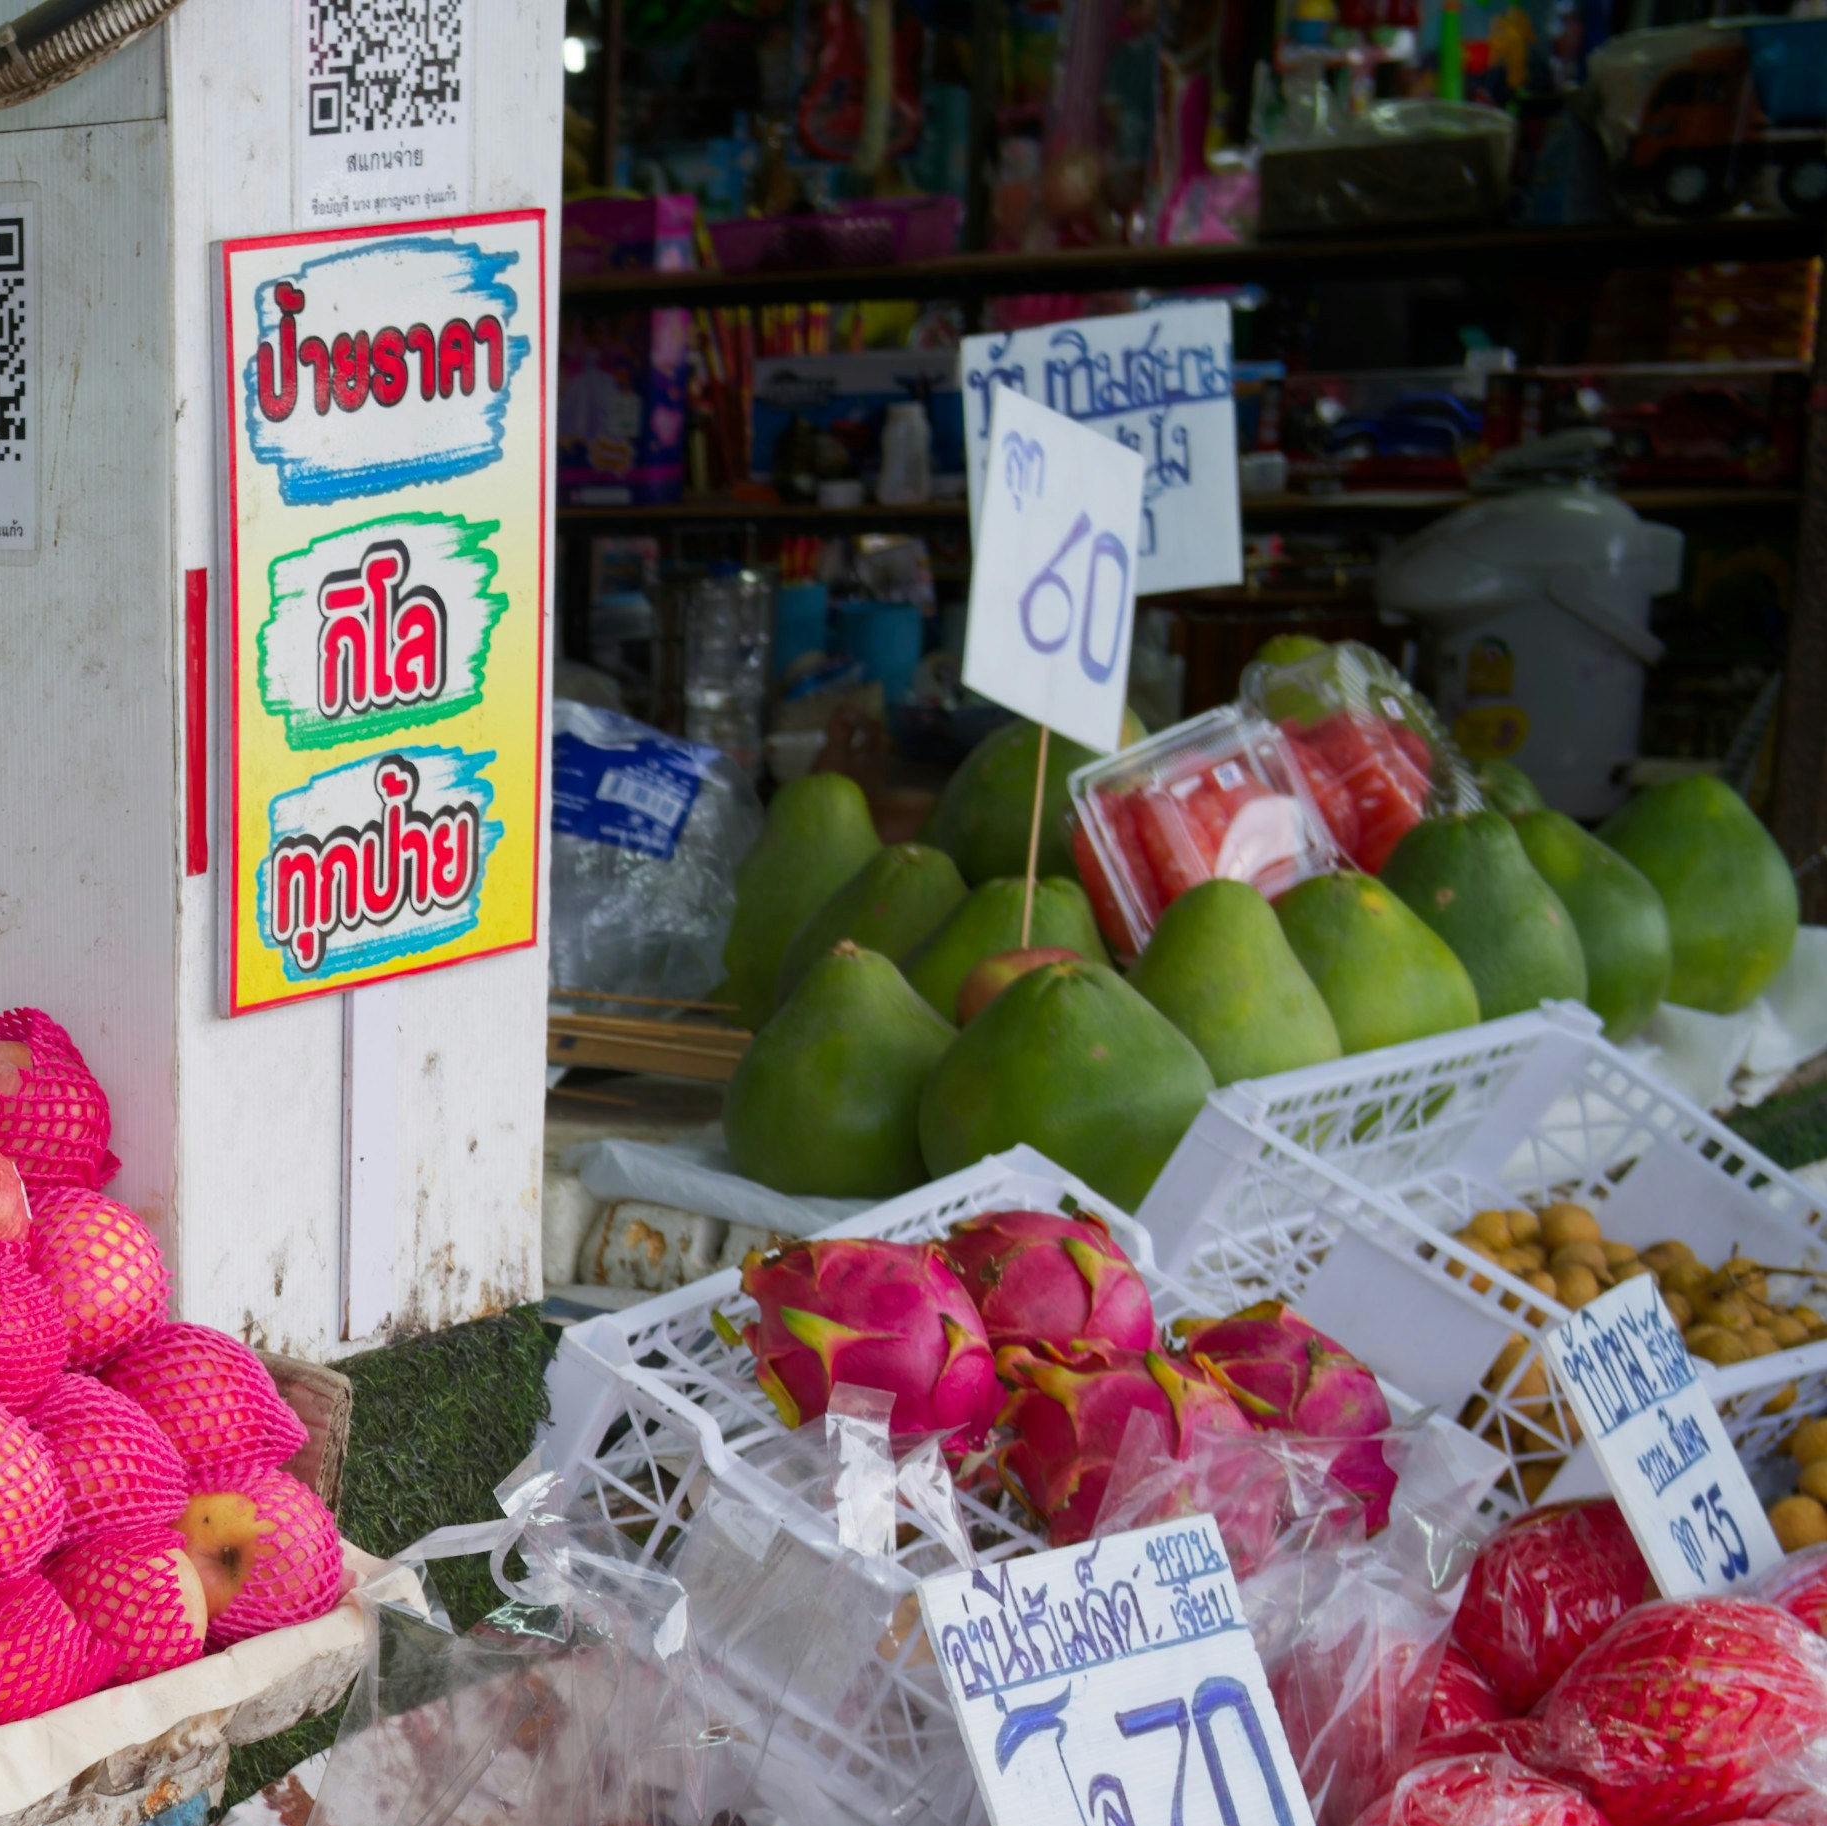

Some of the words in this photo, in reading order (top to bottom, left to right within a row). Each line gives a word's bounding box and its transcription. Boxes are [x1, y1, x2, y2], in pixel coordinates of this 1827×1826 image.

[347, 141, 424, 172] สแกนจ่าย
[255, 281, 507, 423] ป้ายราคา
[321, 545, 444, 716] กิโล
[1018, 509, 1130, 686] 60
[273, 755, 477, 971] ทุกป้าย
[1146, 1526, 1227, 1586] หวาน
[1692, 1482, 1750, 1582] 35
